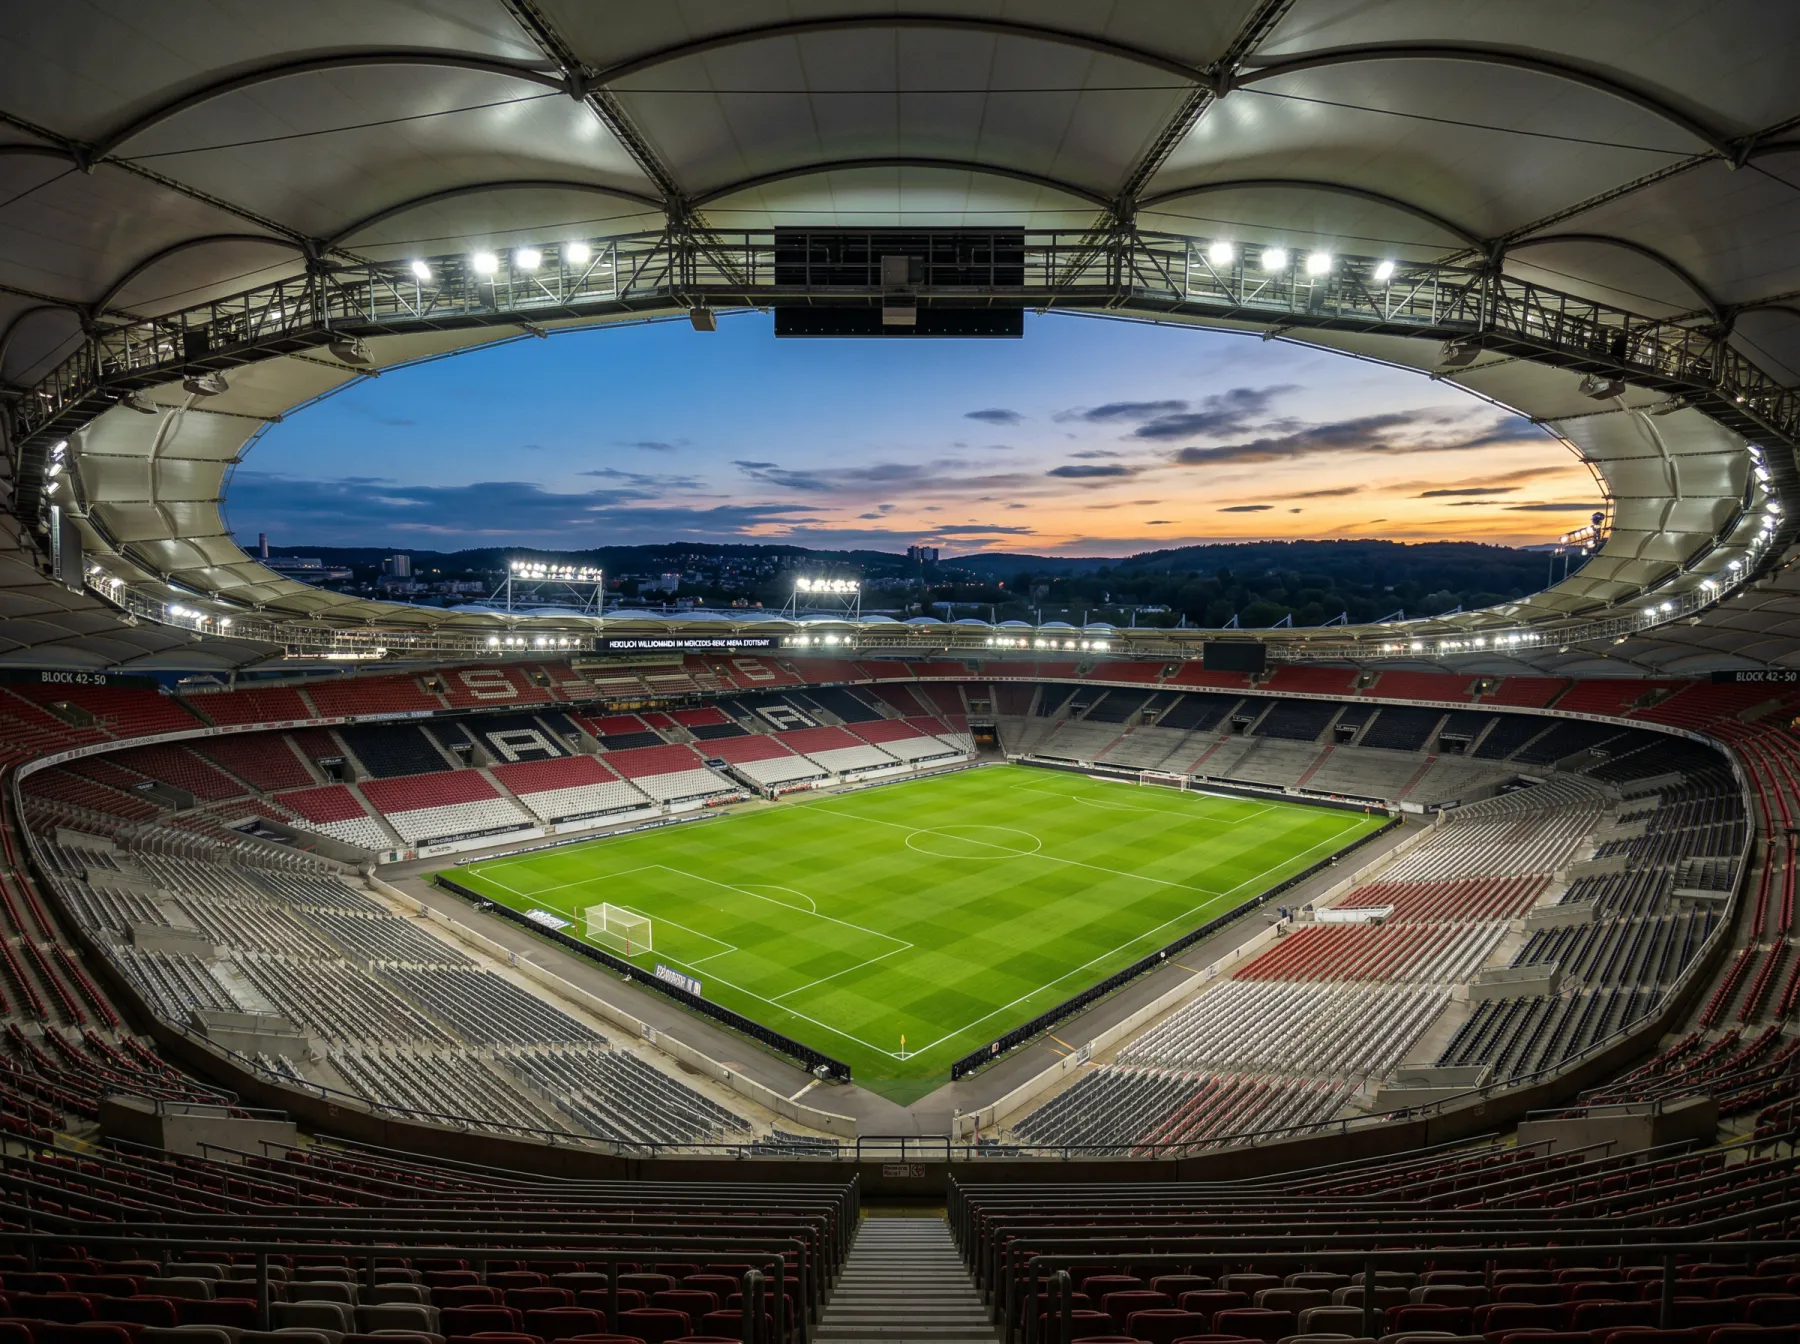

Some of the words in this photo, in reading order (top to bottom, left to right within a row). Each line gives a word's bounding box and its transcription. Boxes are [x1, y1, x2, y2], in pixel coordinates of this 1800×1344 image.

[41, 671, 73, 684] BLOCK
[75, 672, 107, 685] 42-50
[458, 669, 518, 699] S
[1736, 671, 1764, 682] BLOCK
[486, 728, 562, 762] A
